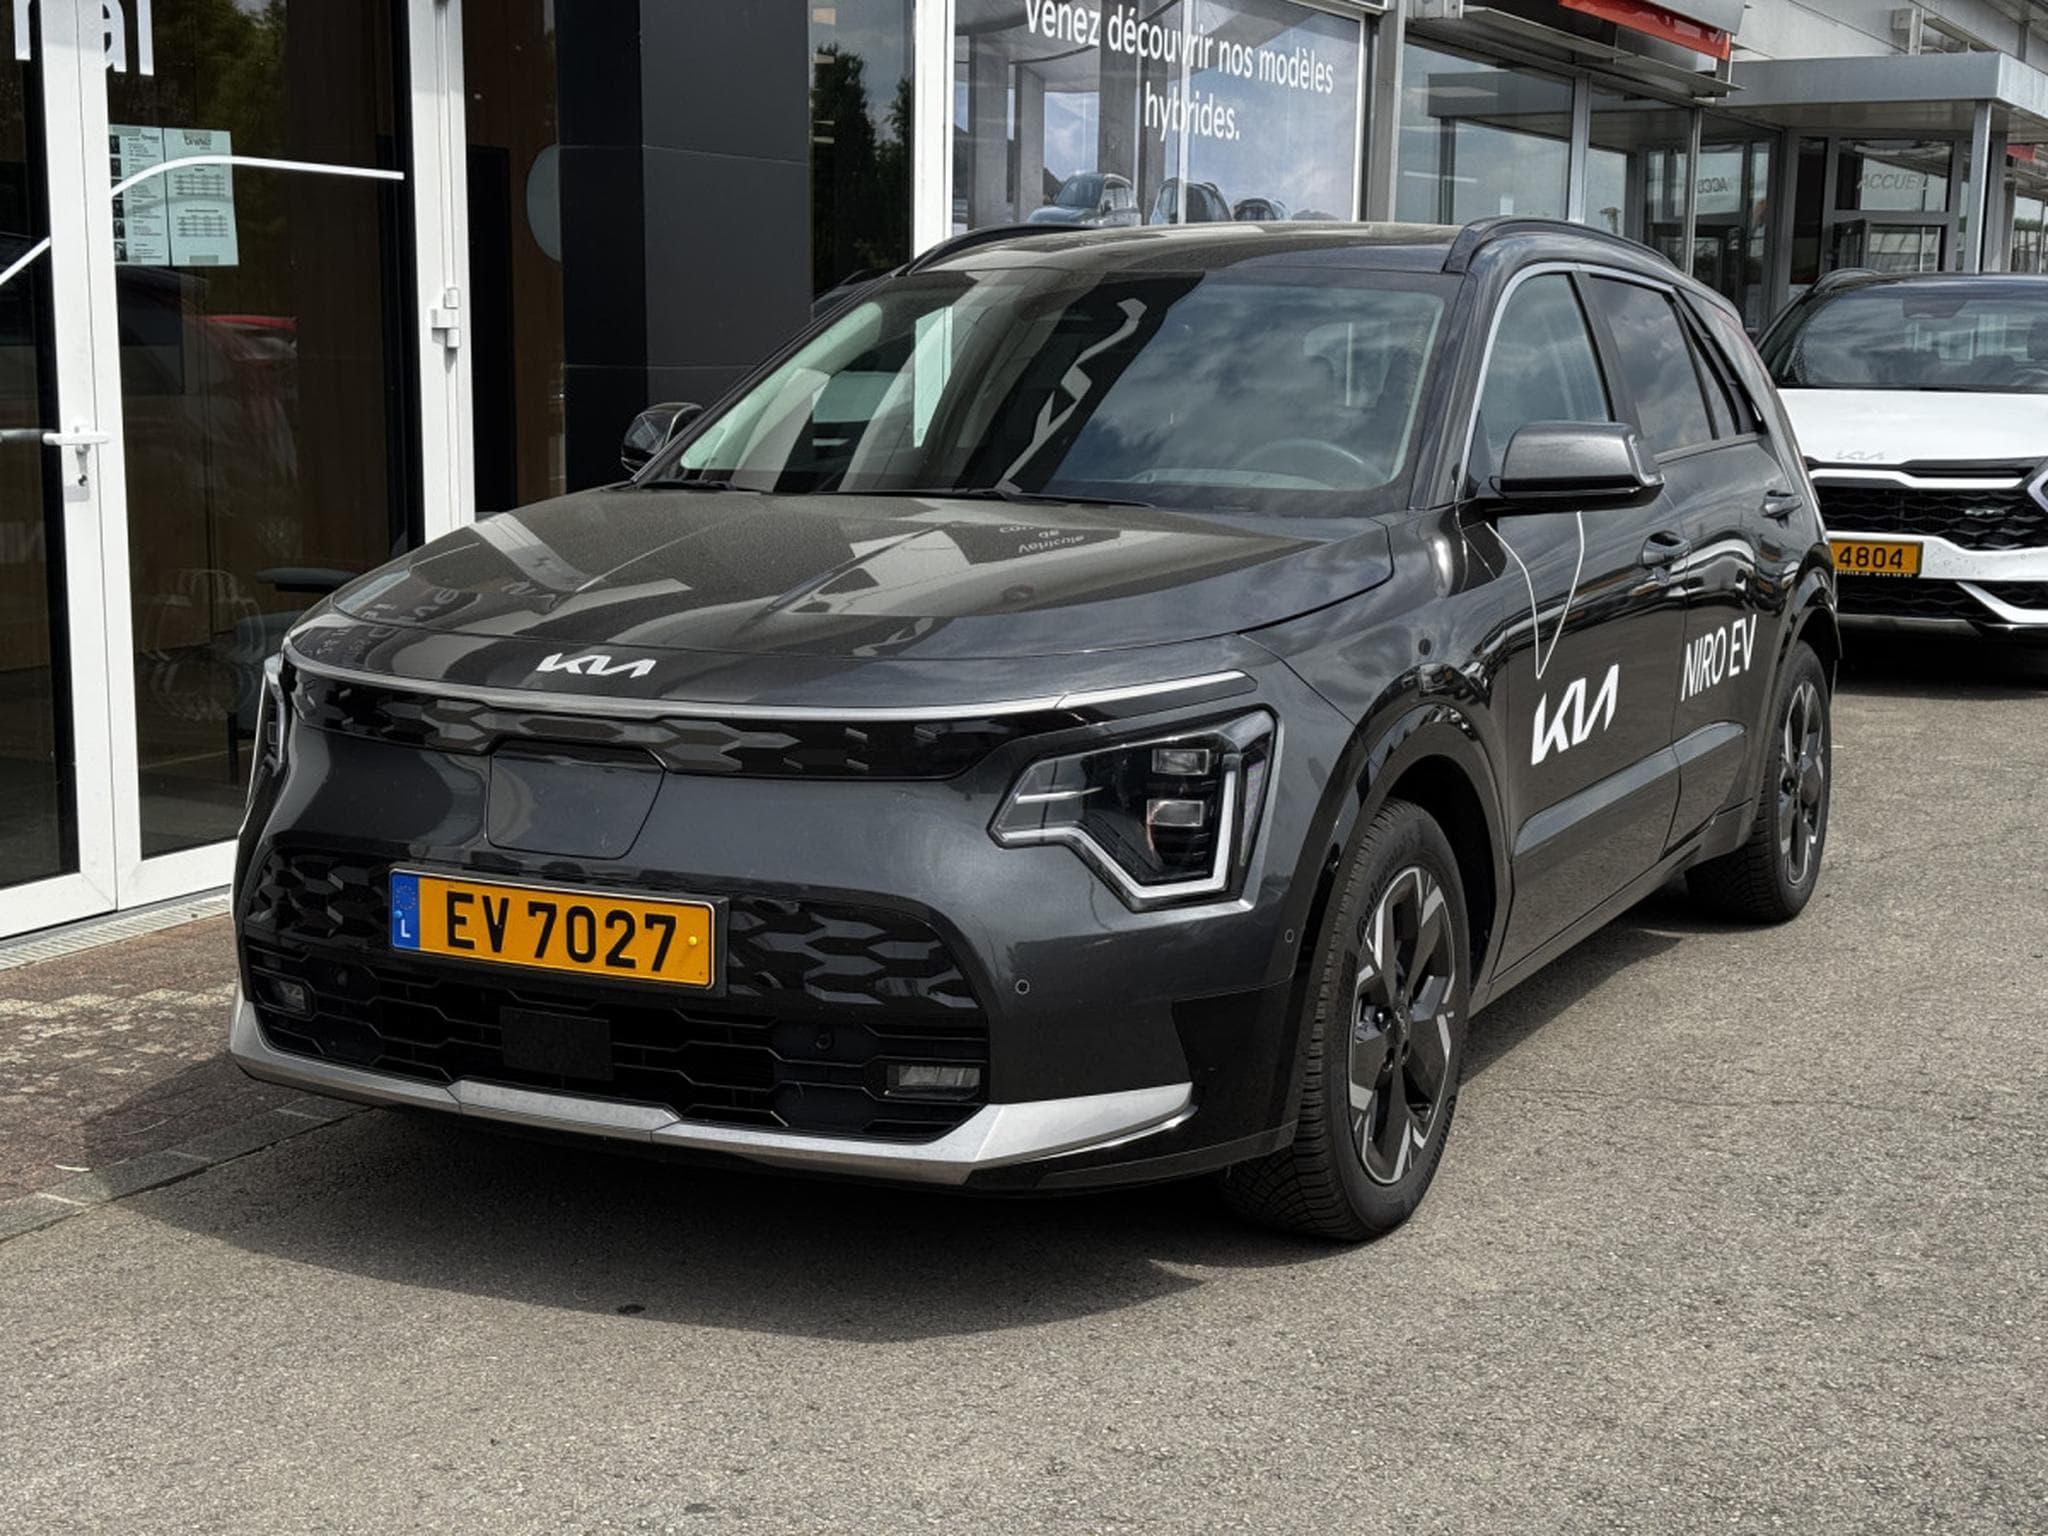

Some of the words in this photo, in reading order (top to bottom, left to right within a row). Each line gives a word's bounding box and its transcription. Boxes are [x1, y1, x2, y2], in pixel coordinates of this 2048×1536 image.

[1107, 4, 1214, 69] découvrir
[1218, 40, 1254, 79] nos
[1258, 46, 1334, 94] modèles
[1145, 81, 1240, 142] hybrides.
[1839, 546, 1903, 569] 4804
[536, 652, 658, 679] KIA
[1681, 627, 1727, 702] NIRO
[1729, 613, 1757, 678] EV
[1530, 663, 1620, 767] KIA
[400, 918, 411, 938] L
[446, 891, 510, 953] EV
[528, 901, 677, 972] 7027
